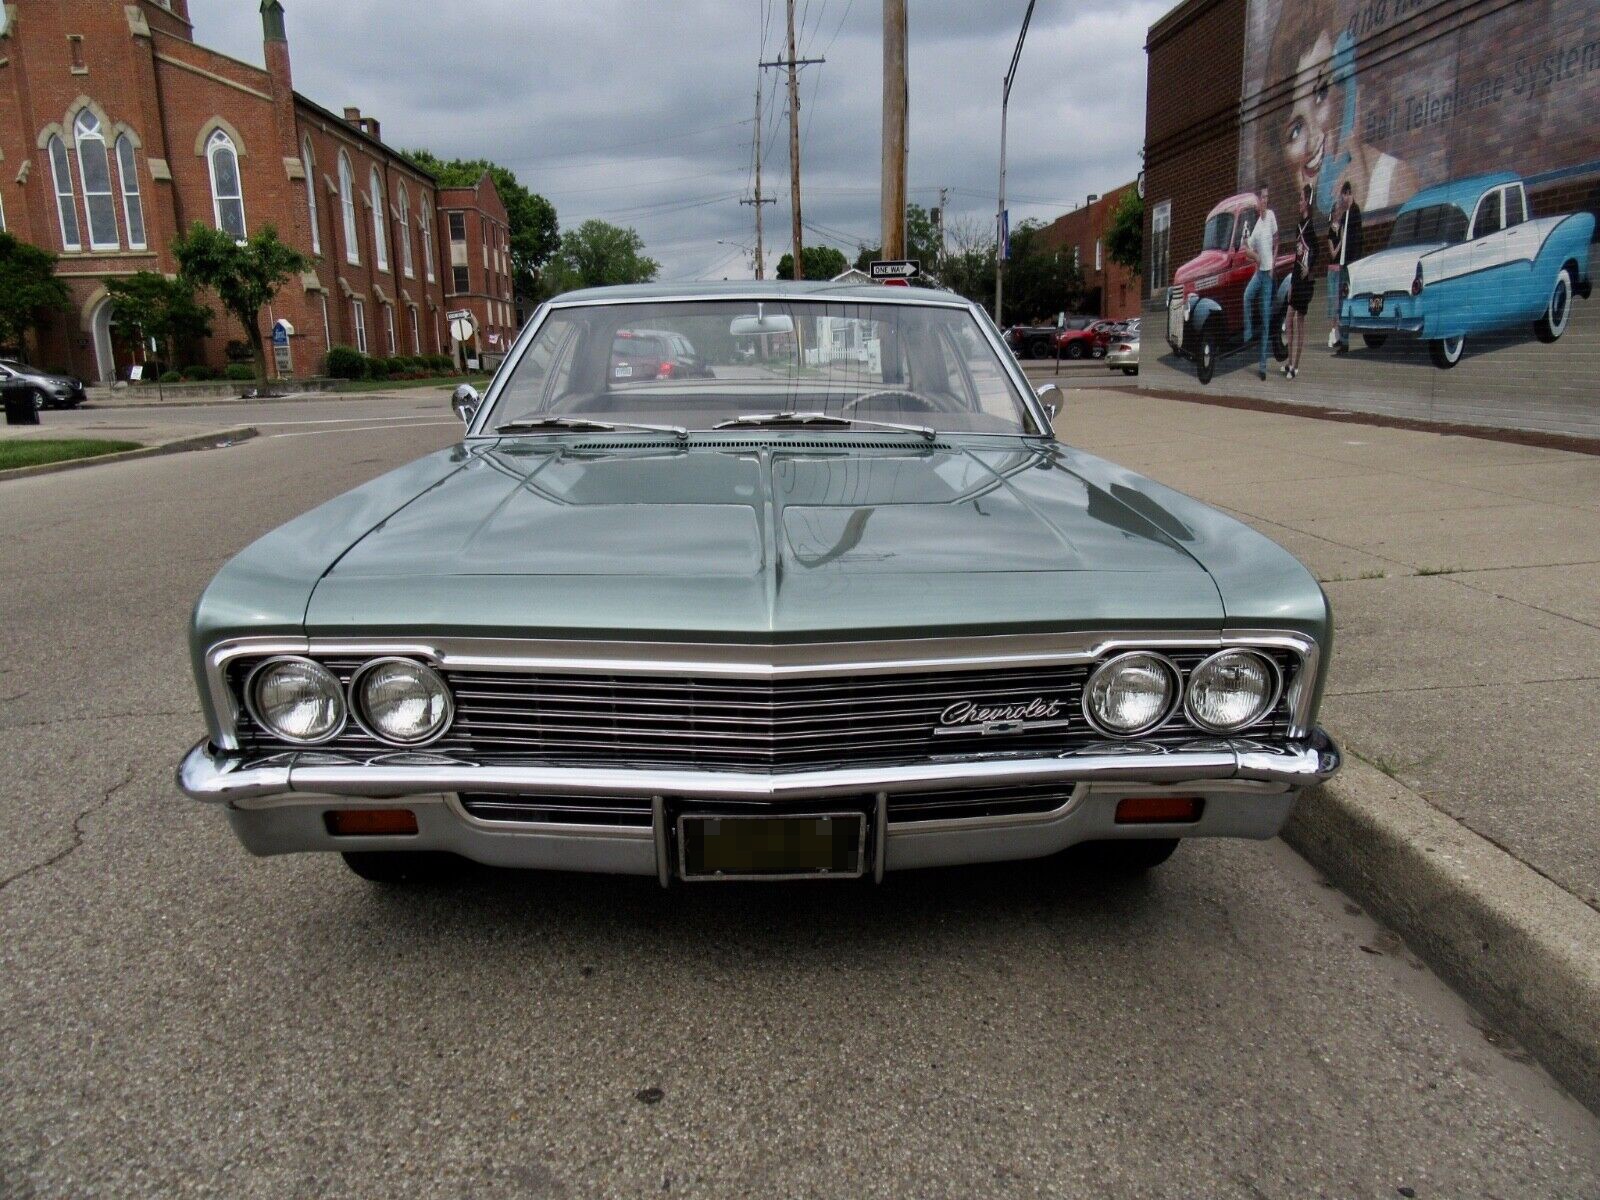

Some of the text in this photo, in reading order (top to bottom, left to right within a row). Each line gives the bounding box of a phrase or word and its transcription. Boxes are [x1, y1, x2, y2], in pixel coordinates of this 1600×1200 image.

[1513, 38, 1600, 101] System
[875, 265, 905, 274] ONE WAY
[940, 697, 1060, 725] Chevrolet
